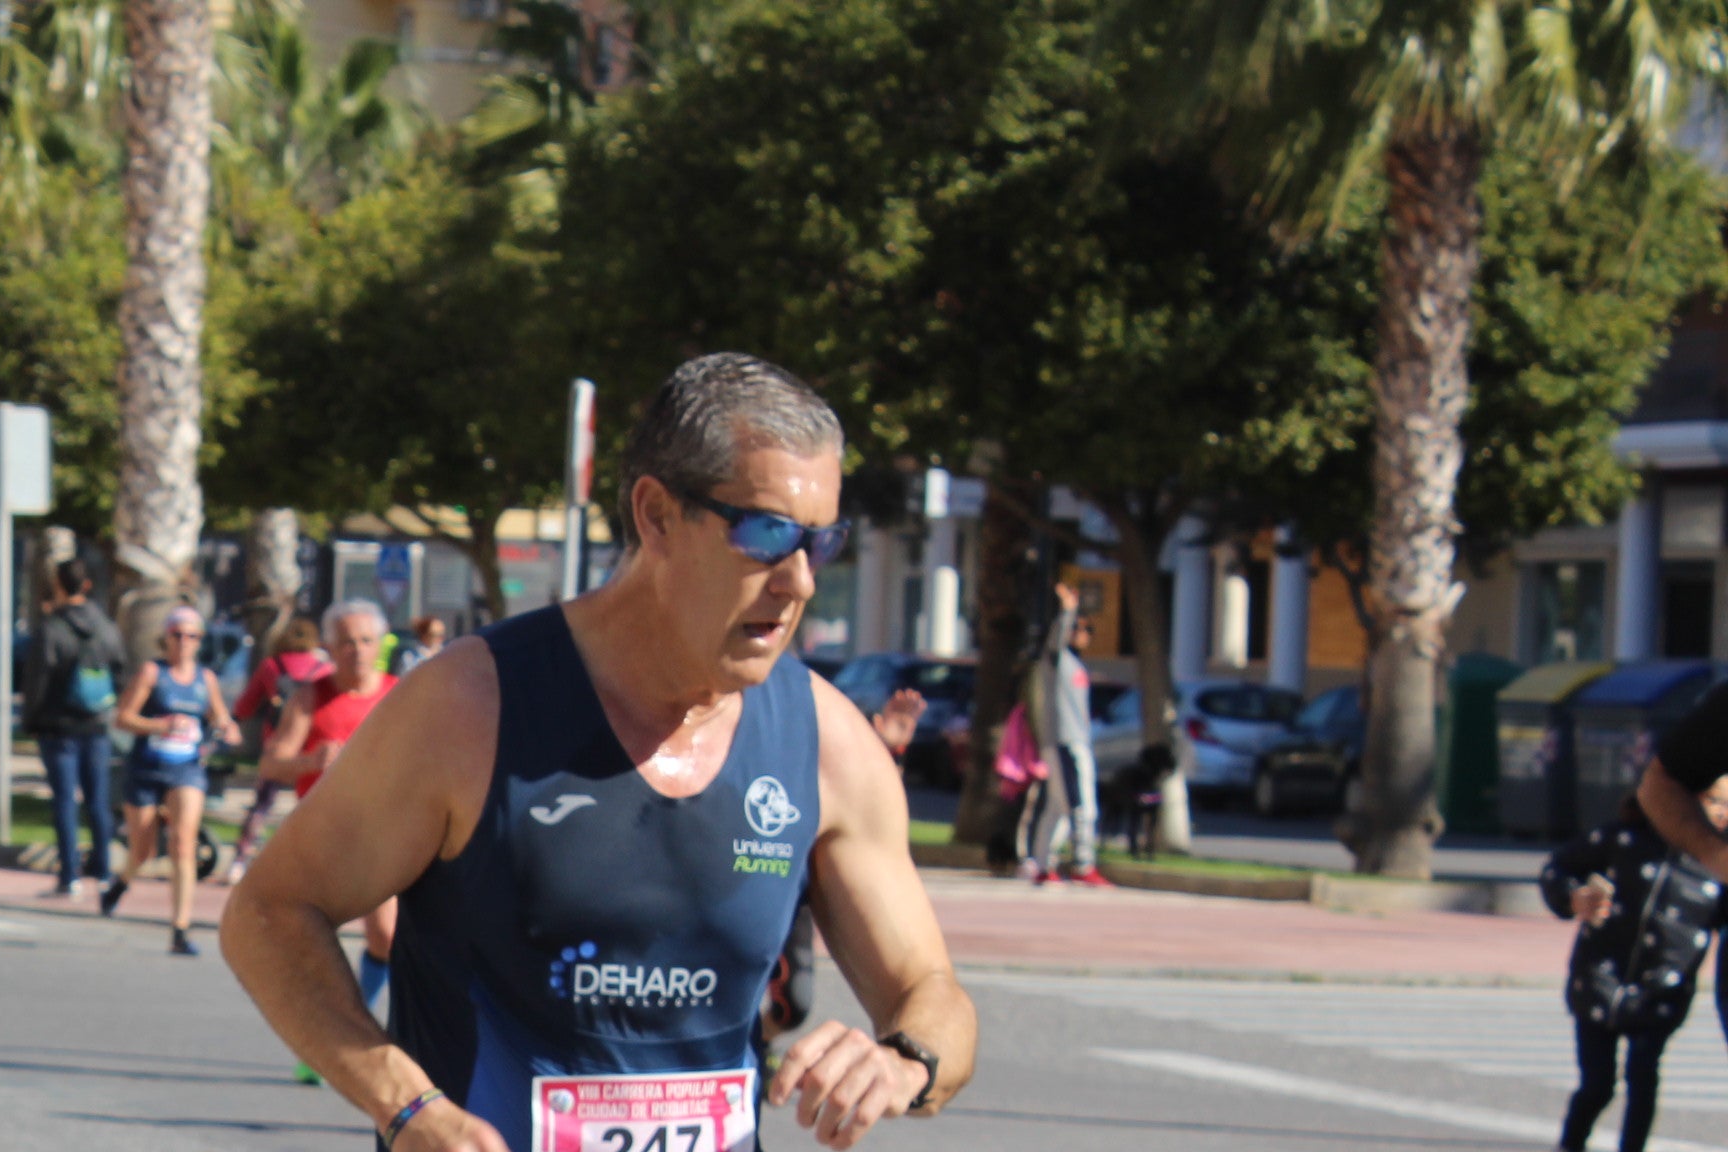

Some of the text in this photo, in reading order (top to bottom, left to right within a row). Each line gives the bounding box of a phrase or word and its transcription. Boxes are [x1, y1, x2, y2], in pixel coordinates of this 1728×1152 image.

[733, 855, 791, 878] Running
[574, 963, 718, 998] DEHARO
[602, 1082, 664, 1100] CARRERA
[665, 1080, 717, 1099] POPULAR
[577, 1101, 629, 1119] CIUDAD
